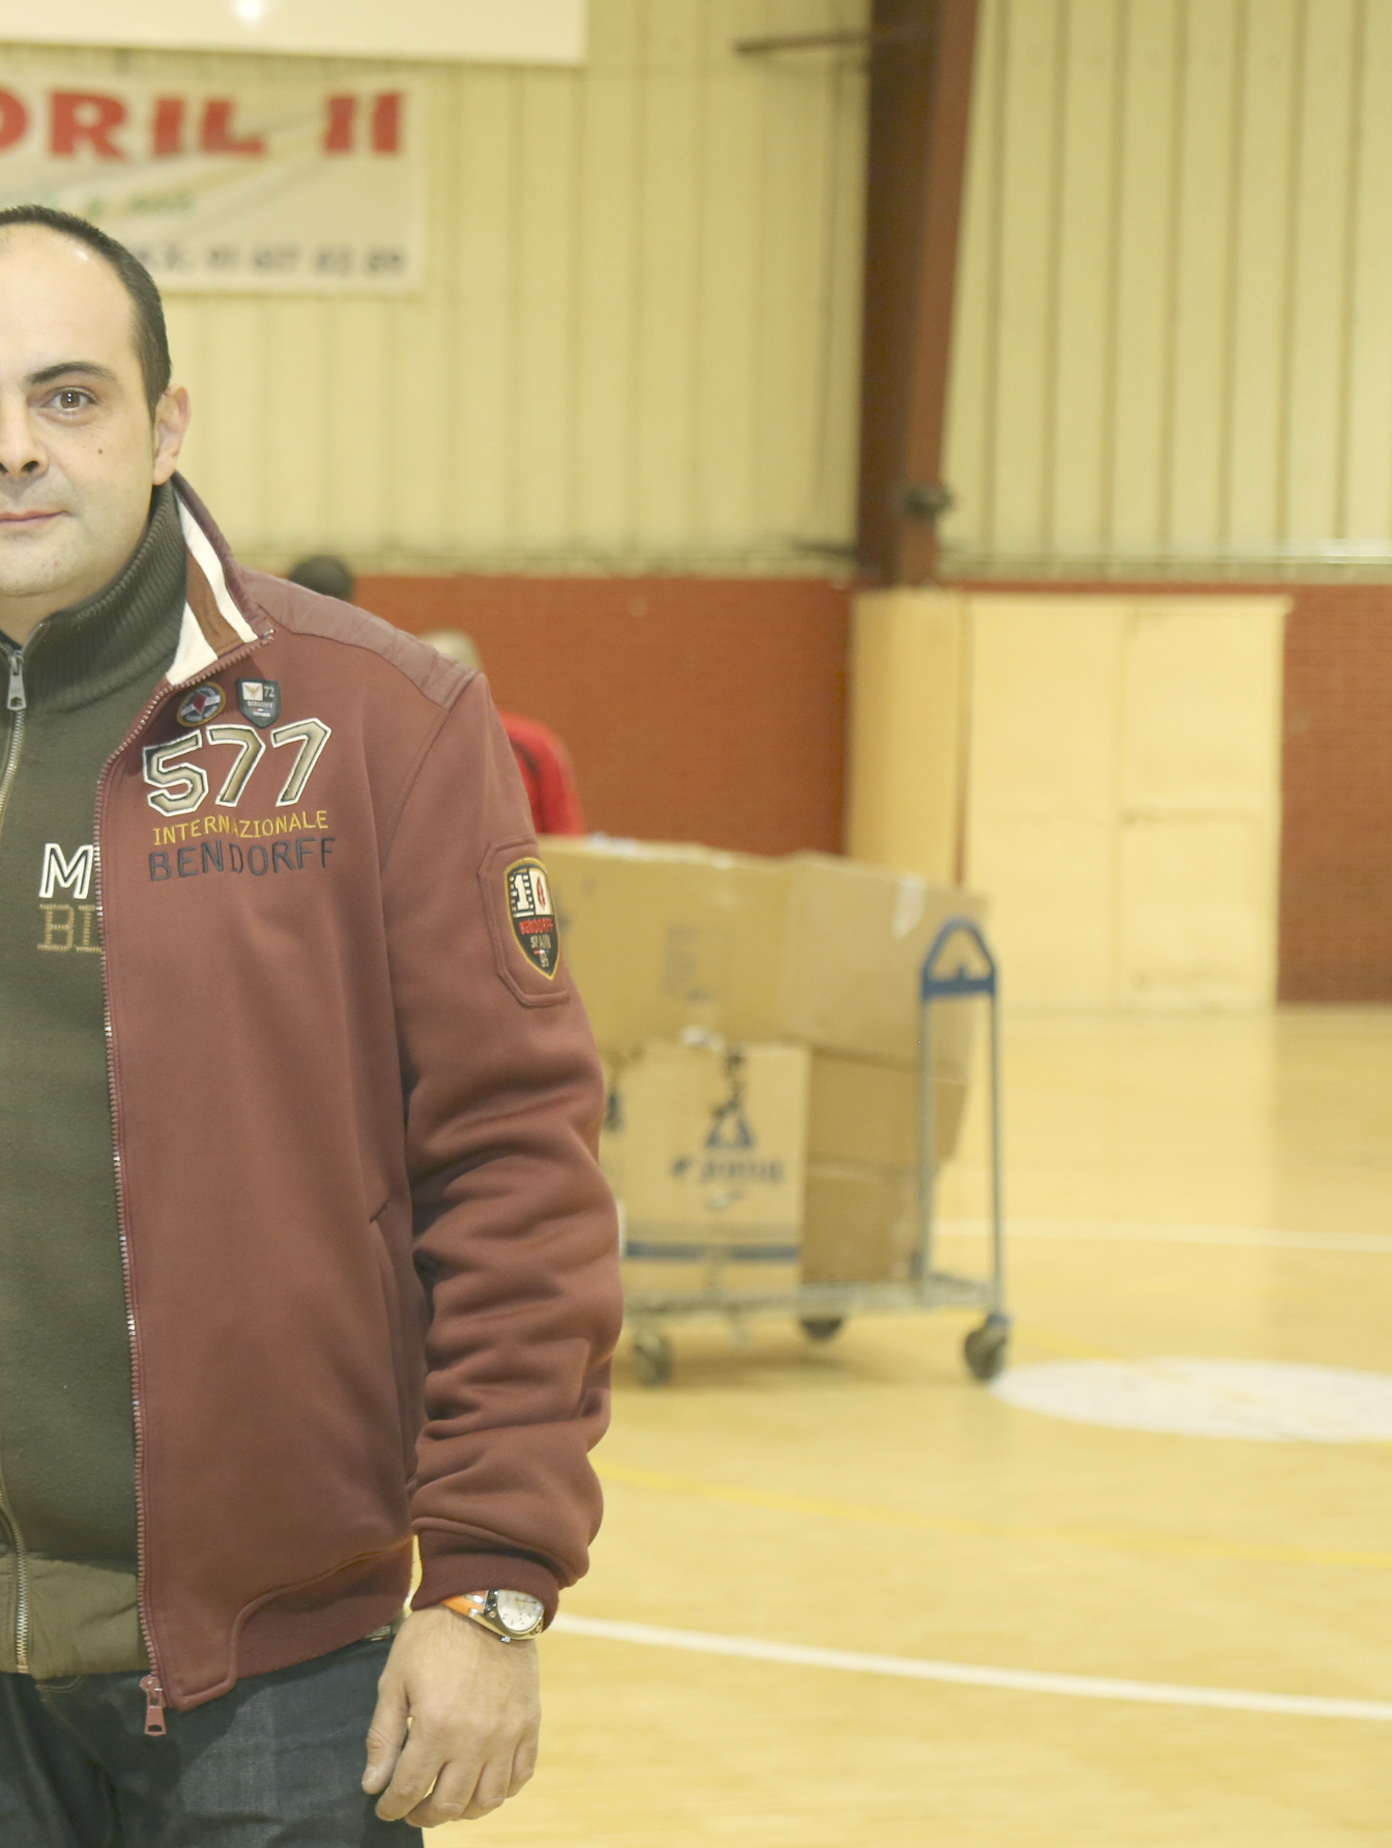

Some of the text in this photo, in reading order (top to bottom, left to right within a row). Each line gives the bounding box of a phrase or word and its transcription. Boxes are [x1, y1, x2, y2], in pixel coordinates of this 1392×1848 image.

[322, 90, 404, 157] II
[264, 686, 276, 698] 72
[142, 717, 333, 818] 577
[148, 836, 336, 882] BENDORFF
